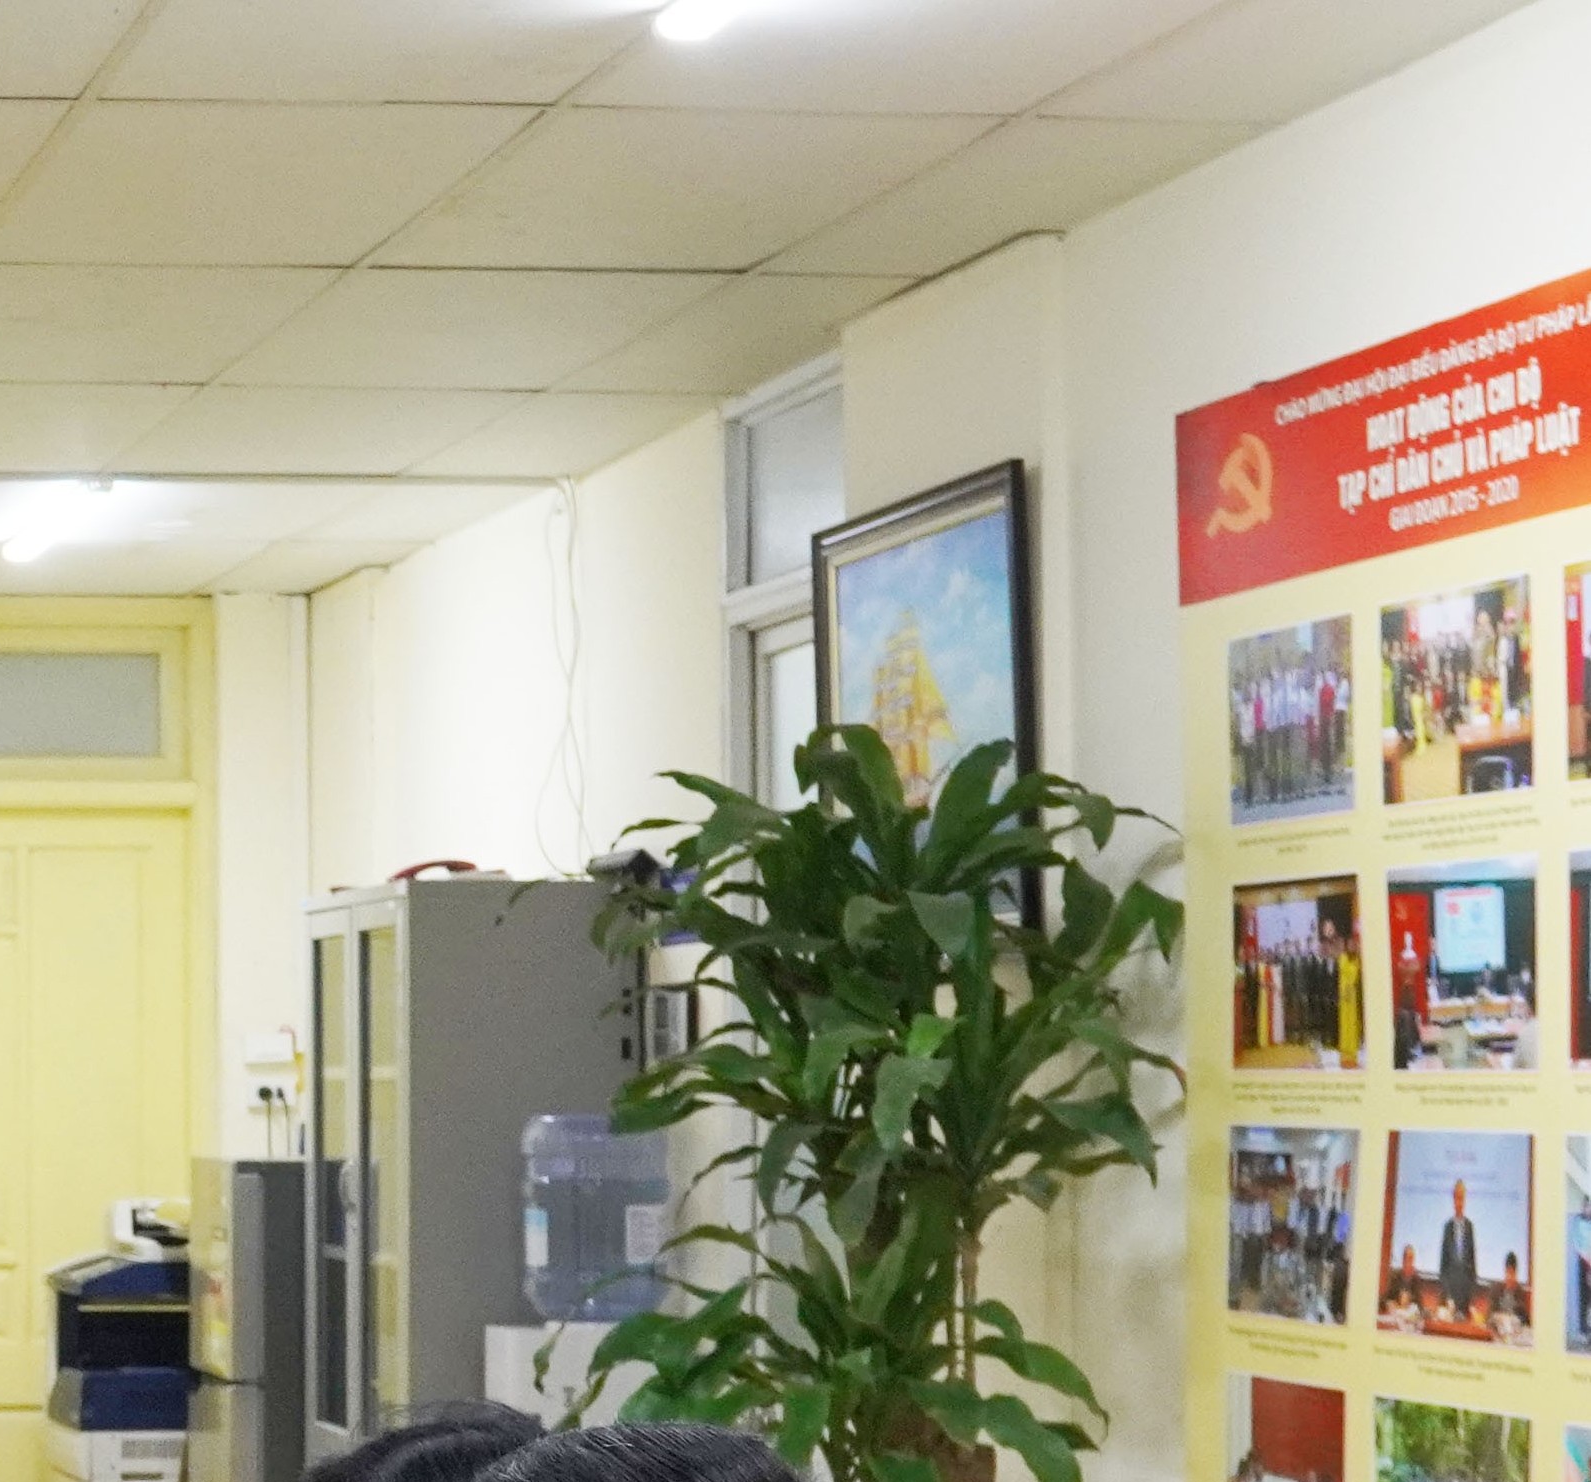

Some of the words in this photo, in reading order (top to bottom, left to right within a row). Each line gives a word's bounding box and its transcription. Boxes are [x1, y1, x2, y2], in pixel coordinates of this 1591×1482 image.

[1337, 470, 1367, 515] TẠP
[1395, 448, 1431, 494] DÂN
[1431, 428, 1464, 484] CHỦ
[1489, 415, 1534, 468] PHÁP
[1533, 402, 1581, 457] LUẬT
